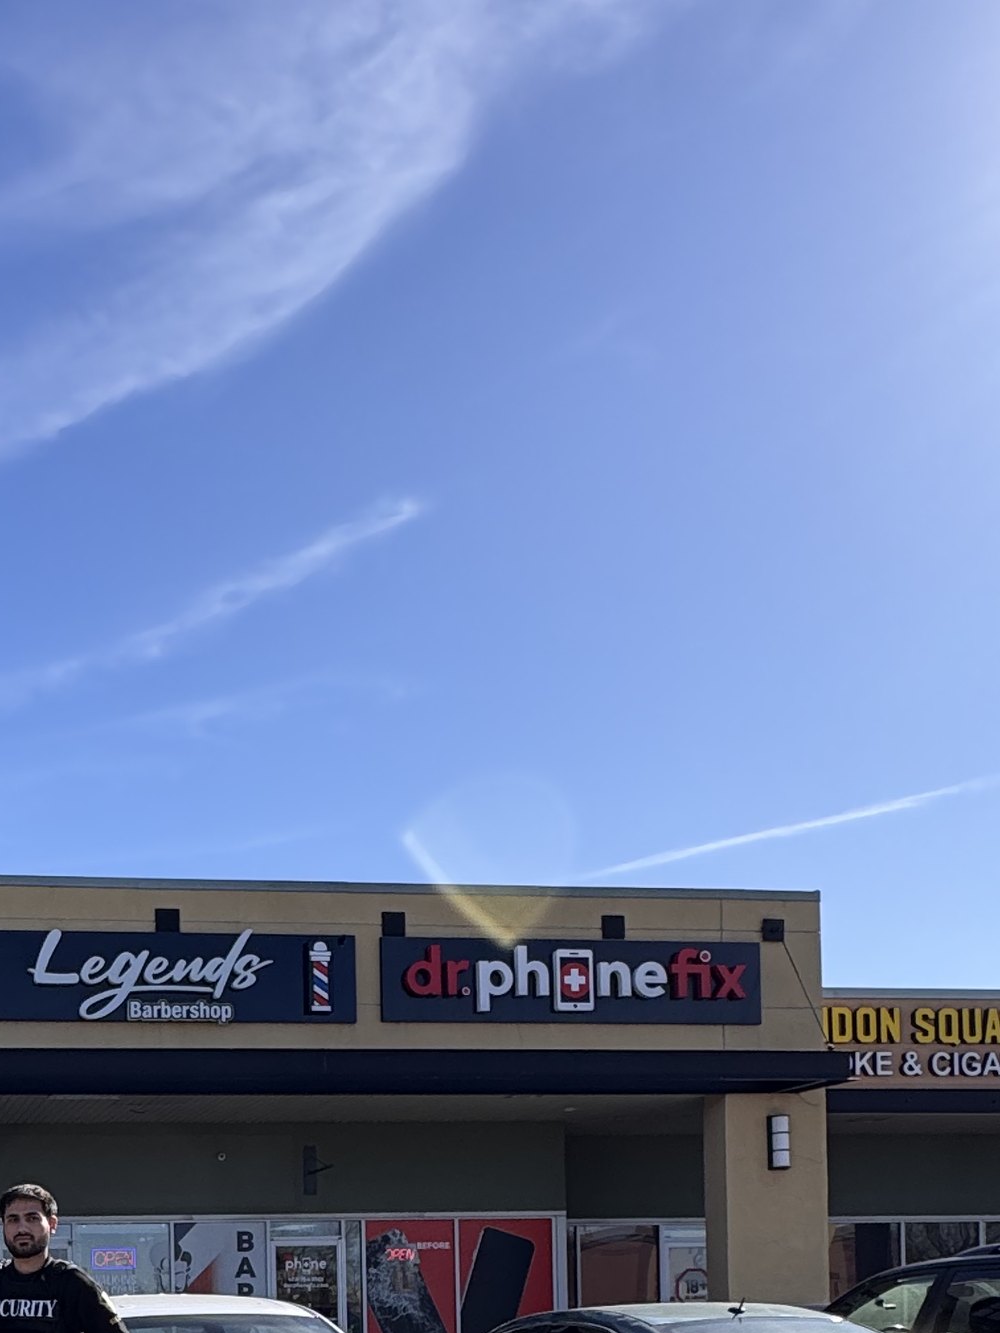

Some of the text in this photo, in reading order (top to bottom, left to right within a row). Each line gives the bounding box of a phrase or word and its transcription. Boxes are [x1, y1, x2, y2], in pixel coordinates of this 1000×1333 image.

[27, 928, 273, 1020] Legends
[127, 999, 233, 1024] Barbershop
[849, 1051, 893, 1076] KE
[902, 1051, 922, 1076] &
[386, 1248, 415, 1262] OPEN
[417, 1242, 451, 1250] BEFORE
[94, 1251, 133, 1267] OPEN
